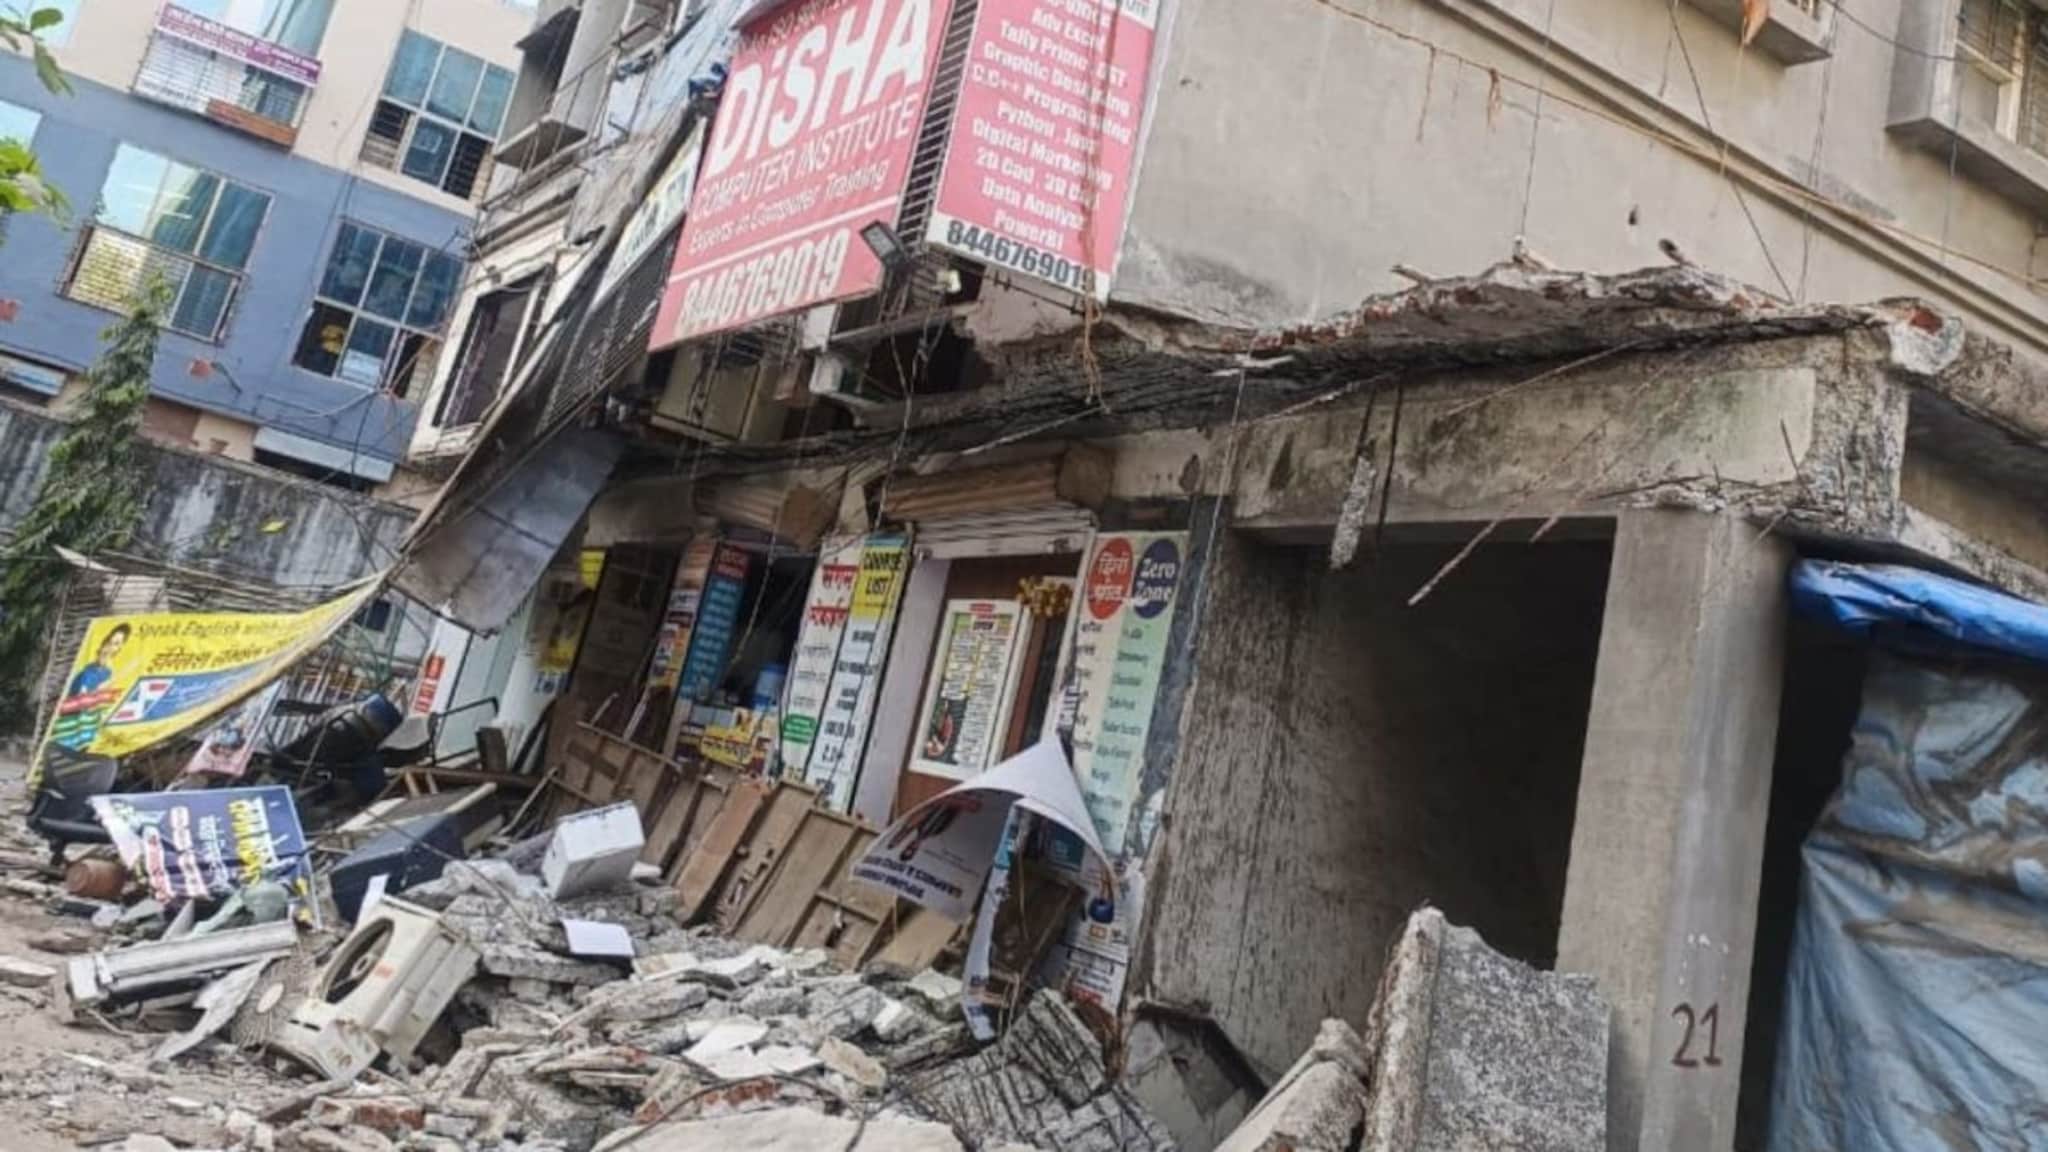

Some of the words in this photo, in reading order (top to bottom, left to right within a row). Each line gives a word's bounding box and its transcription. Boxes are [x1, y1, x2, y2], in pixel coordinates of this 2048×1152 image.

[983, 41, 1049, 80] Graphic
[1001, 20, 1039, 51] Tally
[1040, 38, 1088, 70] Prime
[704, 0, 930, 178] DiSHA
[1023, 83, 1131, 144] Programing
[998, 99, 1055, 136] Python
[693, 149, 795, 220] COMPUTER
[796, 93, 914, 176] INSTITUTE
[972, 117, 1029, 153] Digital
[1029, 143, 1113, 190] Markeing
[981, 176, 1022, 208] Data
[946, 220, 1096, 292] 8446769019
[675, 227, 849, 338] 8446769019
[864, 577, 890, 596] LIST
[1140, 557, 1177, 580] Zero
[1134, 580, 1173, 608] Zone
[183, 621, 242, 642] English
[1671, 1002, 1724, 1068] 21
